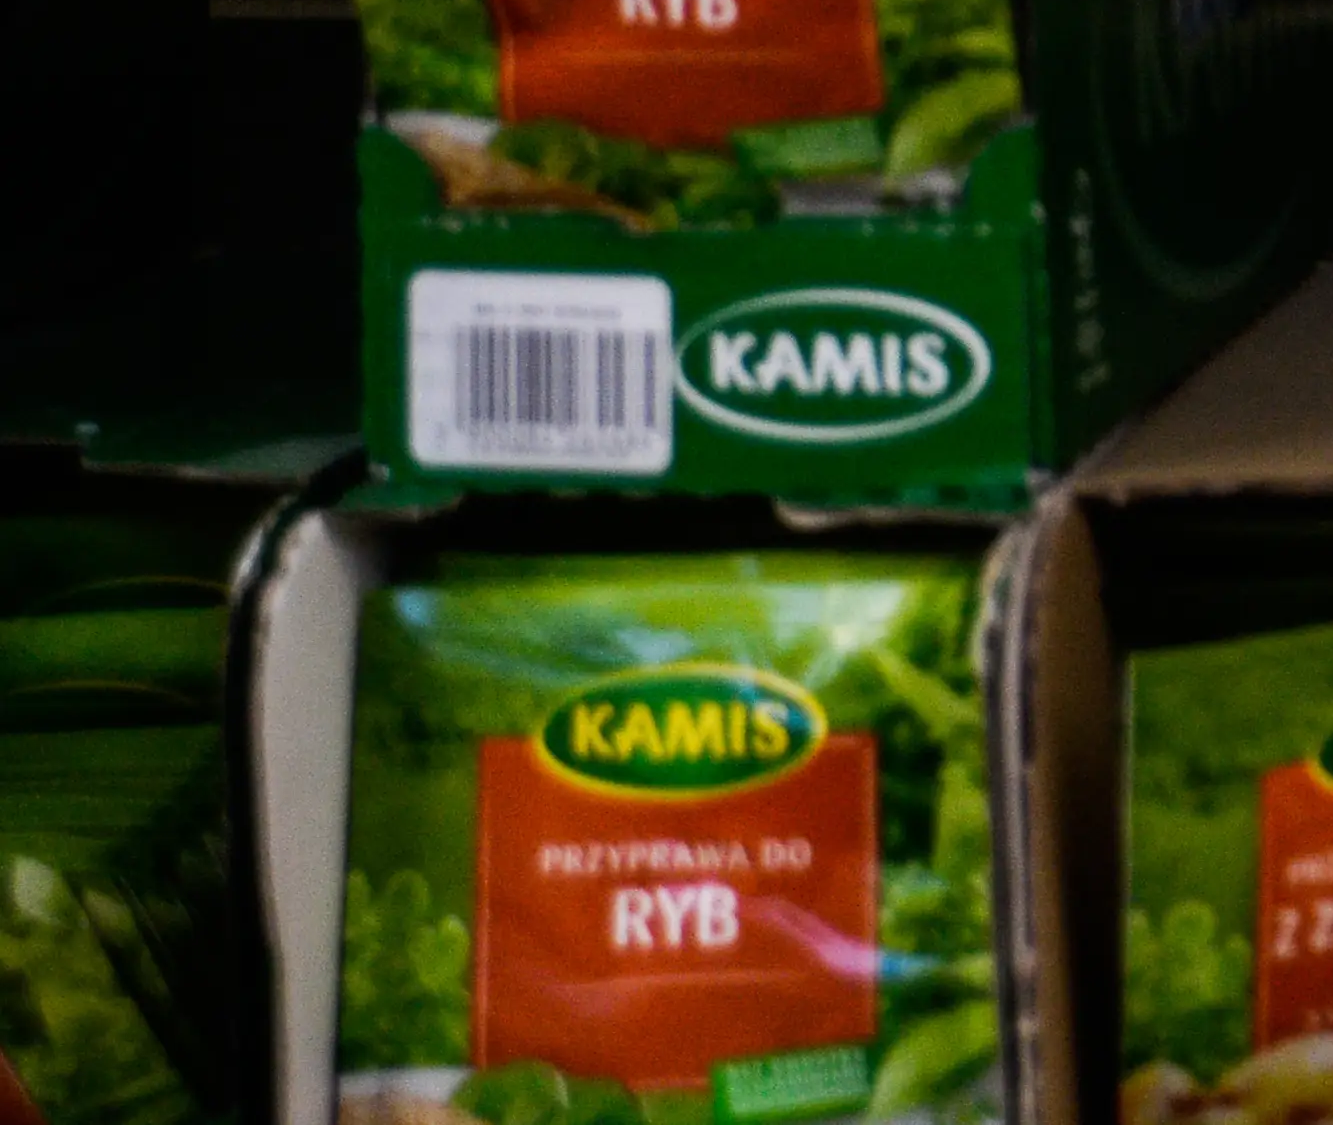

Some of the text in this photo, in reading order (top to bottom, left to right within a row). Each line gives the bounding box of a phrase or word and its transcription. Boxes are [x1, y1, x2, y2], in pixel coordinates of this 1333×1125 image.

[709, 329, 951, 398] KAMIS
[569, 698, 790, 763] KAMIS
[609, 883, 742, 951] RYB
